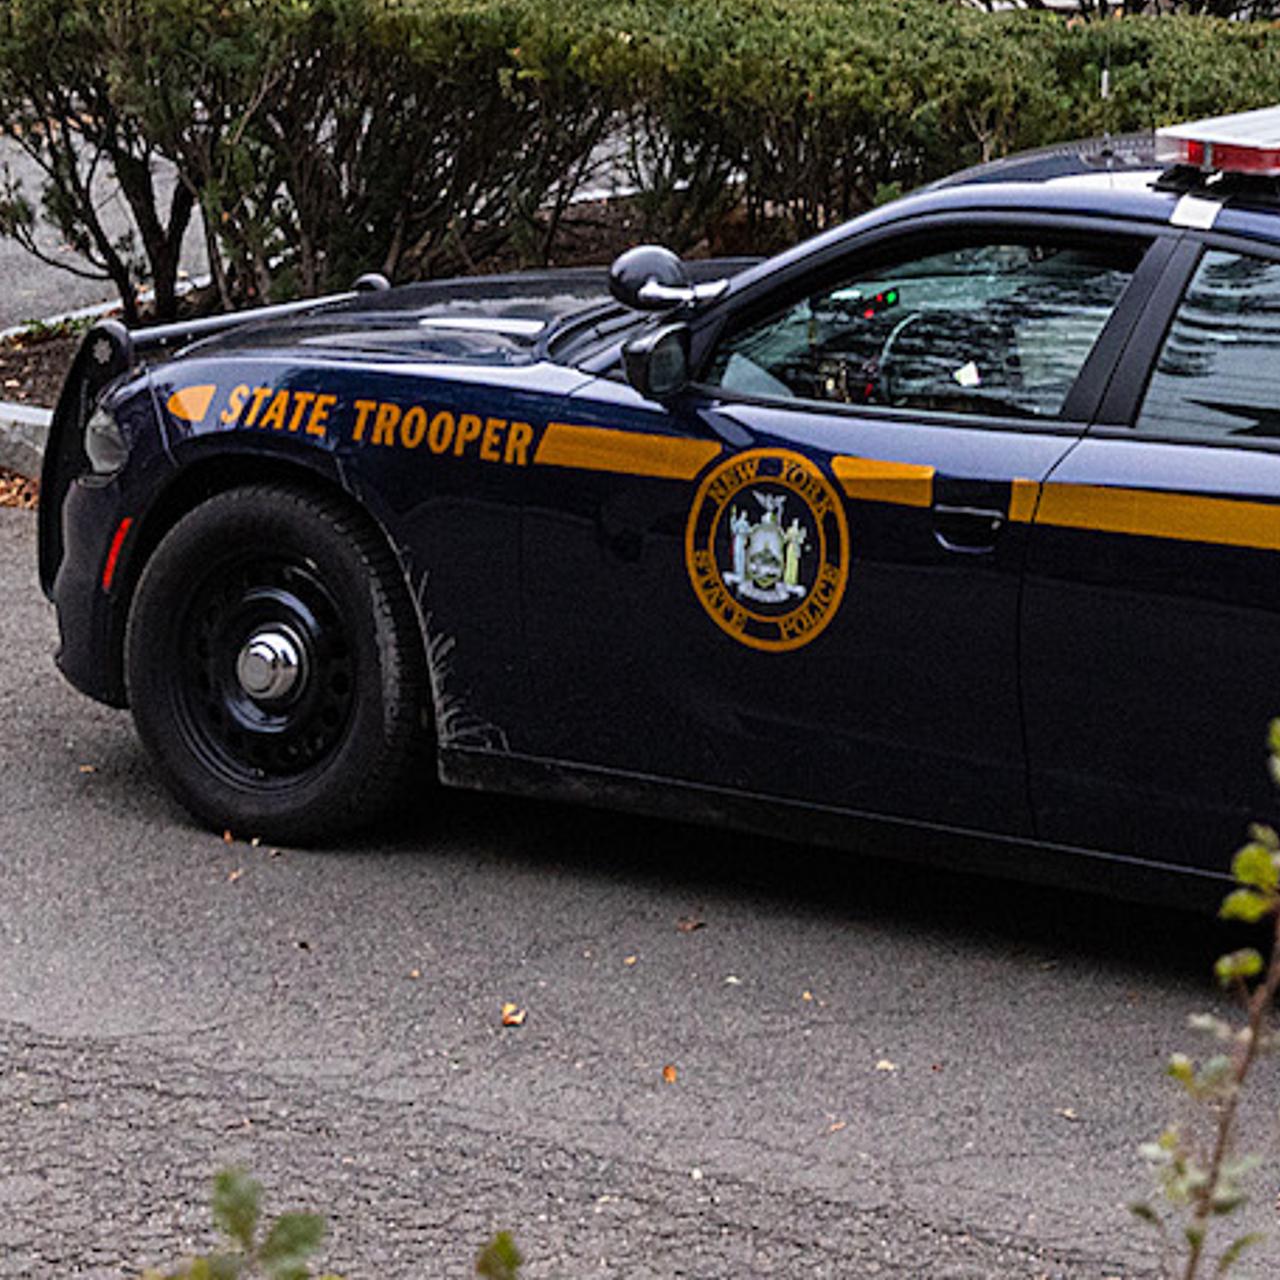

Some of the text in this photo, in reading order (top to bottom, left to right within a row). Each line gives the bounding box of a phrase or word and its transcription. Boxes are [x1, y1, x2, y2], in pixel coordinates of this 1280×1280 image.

[220, 383, 534, 466] STATE TROOPER
[706, 457, 834, 516] NEW YORK
[694, 550, 841, 640] STATE POLICE
